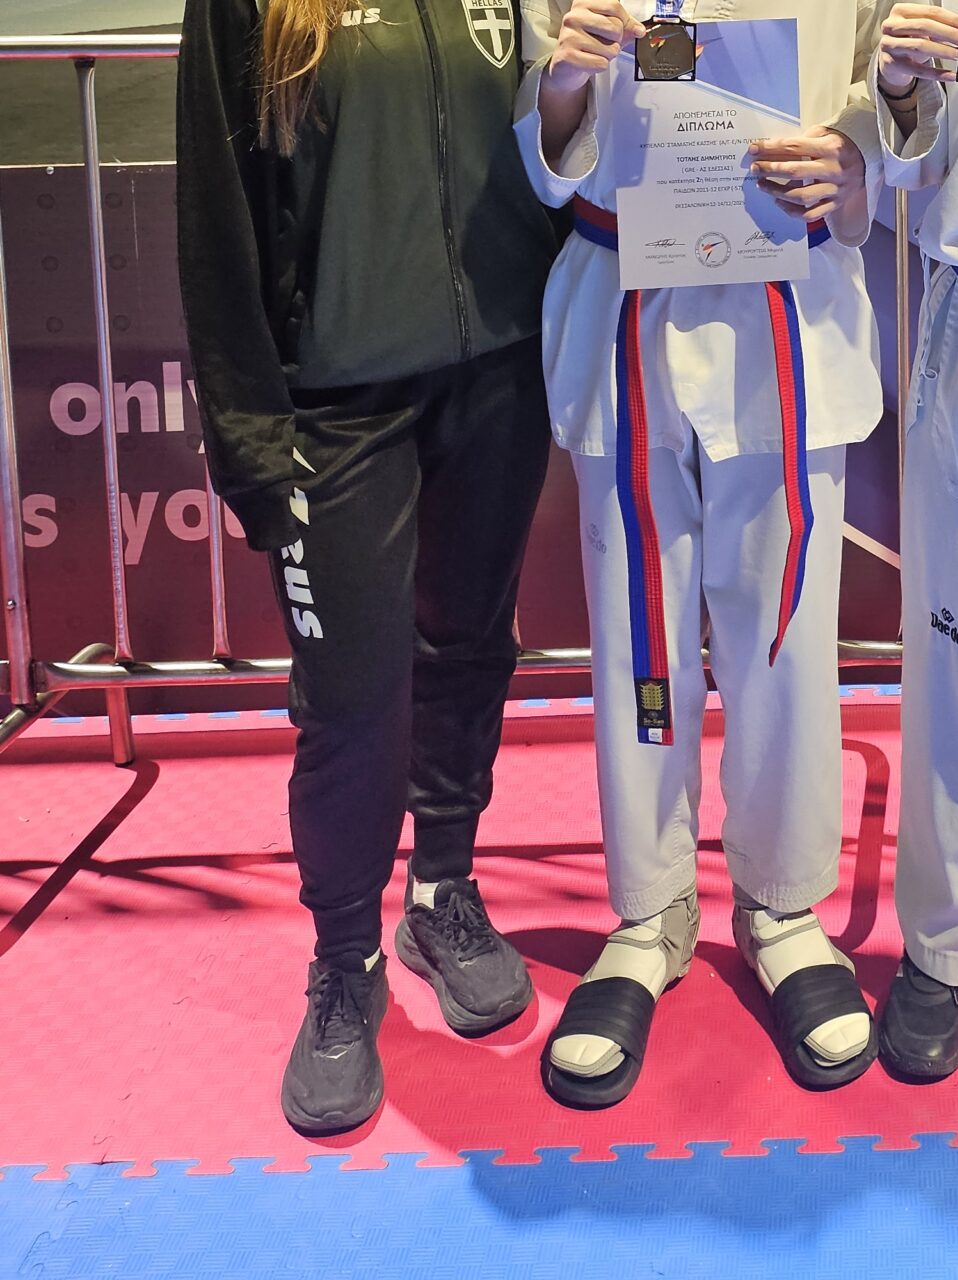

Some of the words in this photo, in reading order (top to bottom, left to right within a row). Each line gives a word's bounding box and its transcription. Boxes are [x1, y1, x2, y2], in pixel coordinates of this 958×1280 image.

[472, 0, 503, 7] HELLAS
[674, 110, 723, 119] ΑΠΟΝΕΜΕΤΑΙ
[677, 121, 735, 132] ΔΙΠΛΩΜΑ
[50, 361, 206, 454] onl
